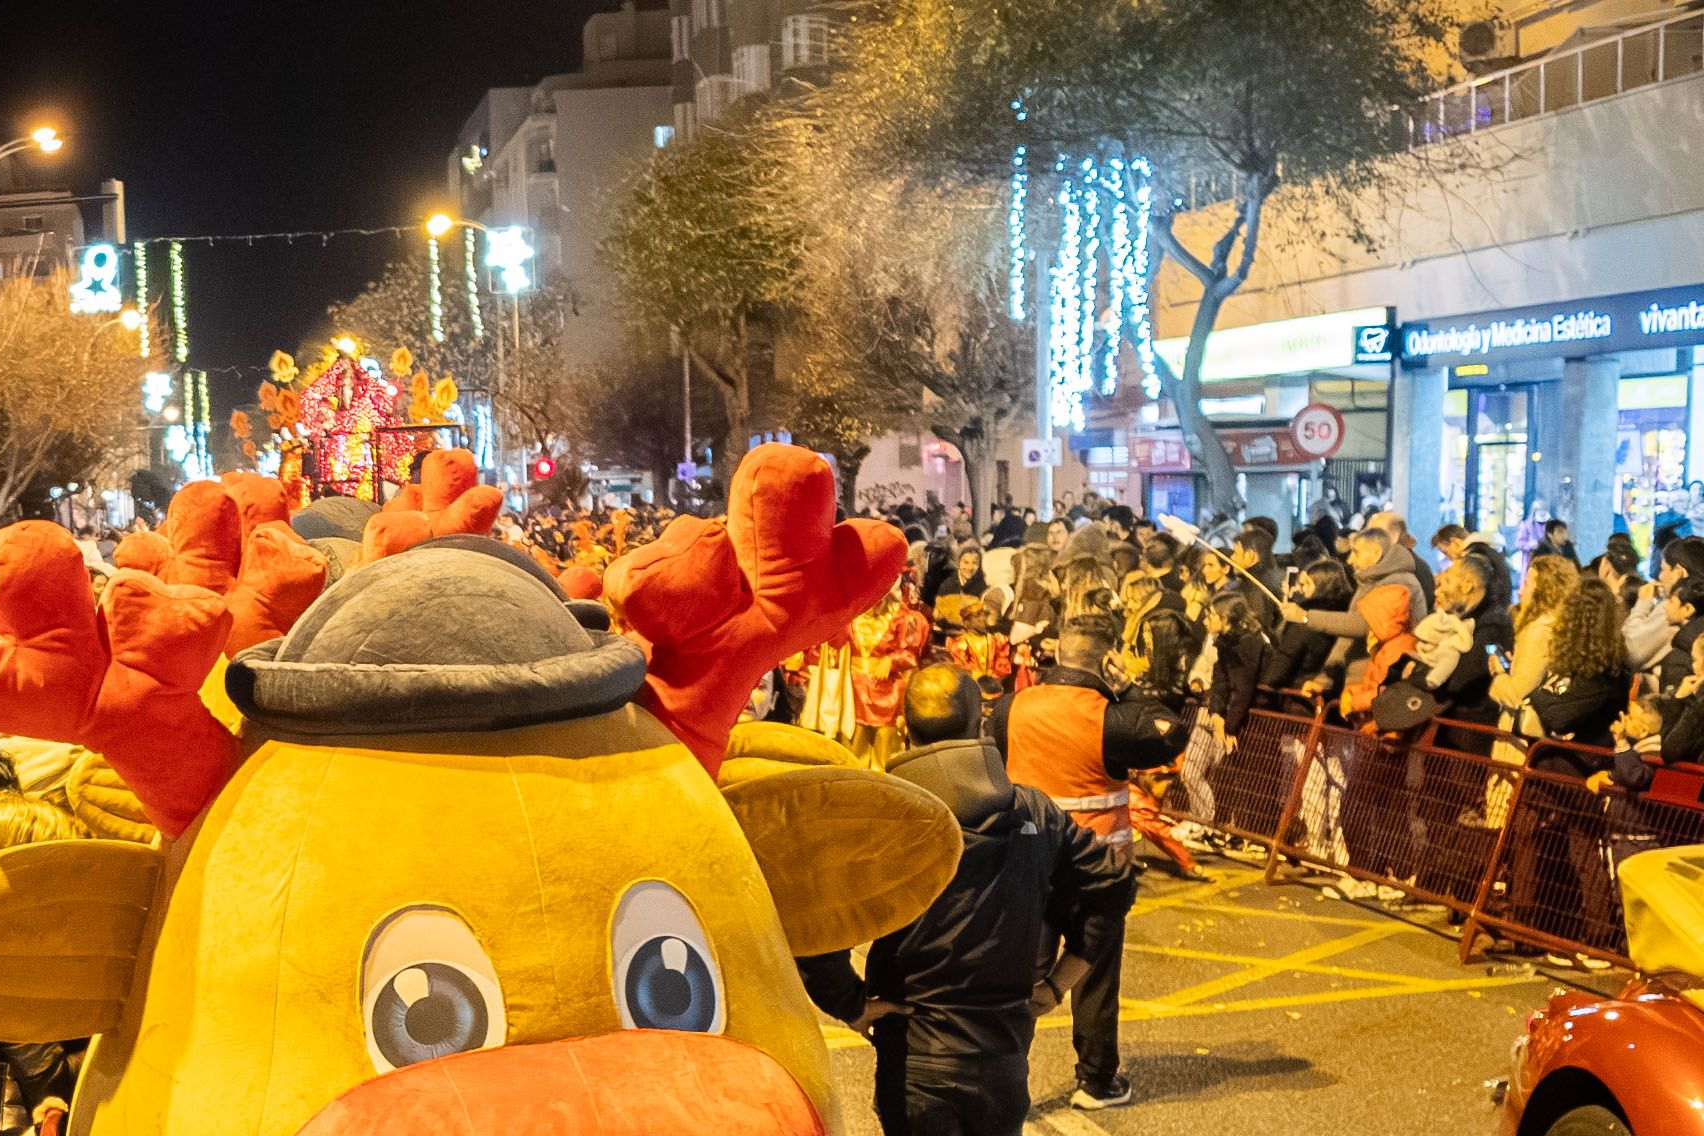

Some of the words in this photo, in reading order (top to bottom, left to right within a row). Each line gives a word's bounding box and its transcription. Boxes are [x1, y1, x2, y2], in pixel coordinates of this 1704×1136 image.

[1481, 327, 1492, 354] y
[1492, 318, 1552, 348] Medicina
[1552, 309, 1612, 342] Estética
[1639, 301, 1704, 334] vivanta
[1303, 421, 1333, 441] 50
